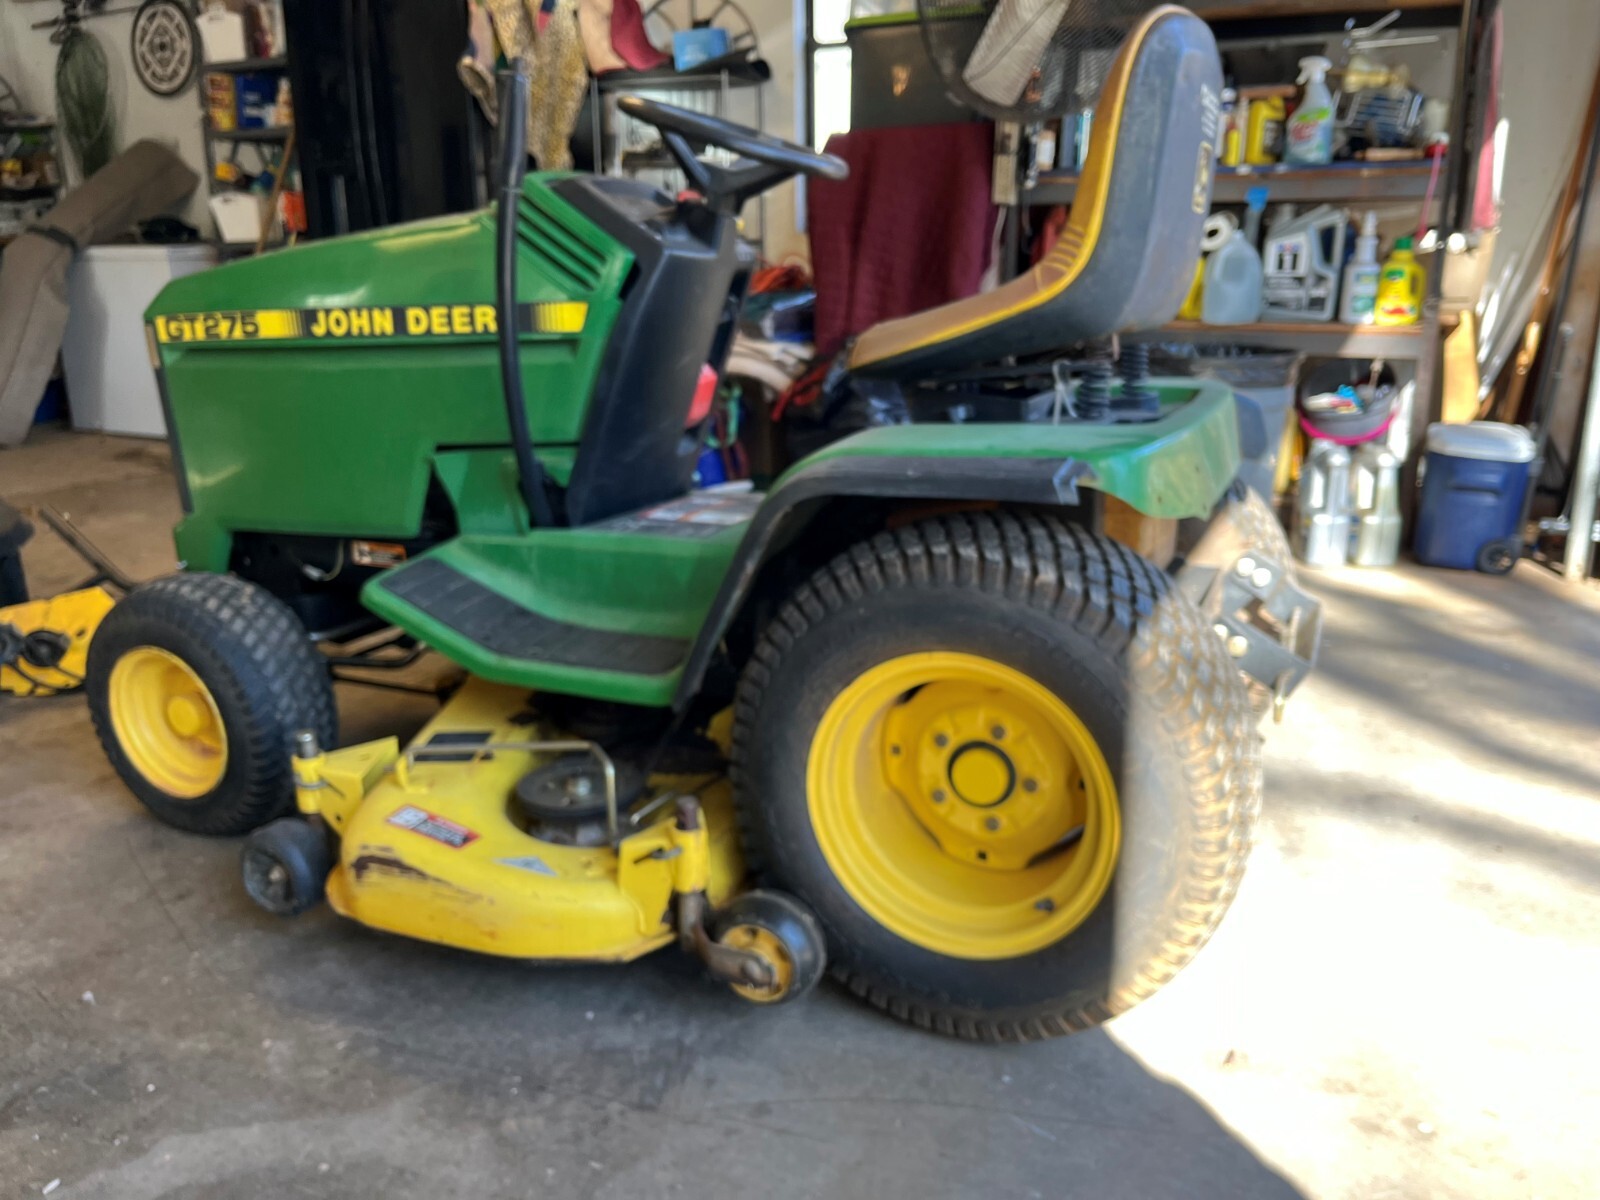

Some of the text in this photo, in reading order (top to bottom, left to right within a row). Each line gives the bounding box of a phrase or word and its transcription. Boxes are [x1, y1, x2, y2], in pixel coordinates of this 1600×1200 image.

[167, 312, 259, 340] GT275
[310, 305, 498, 337] JOHN DEER
